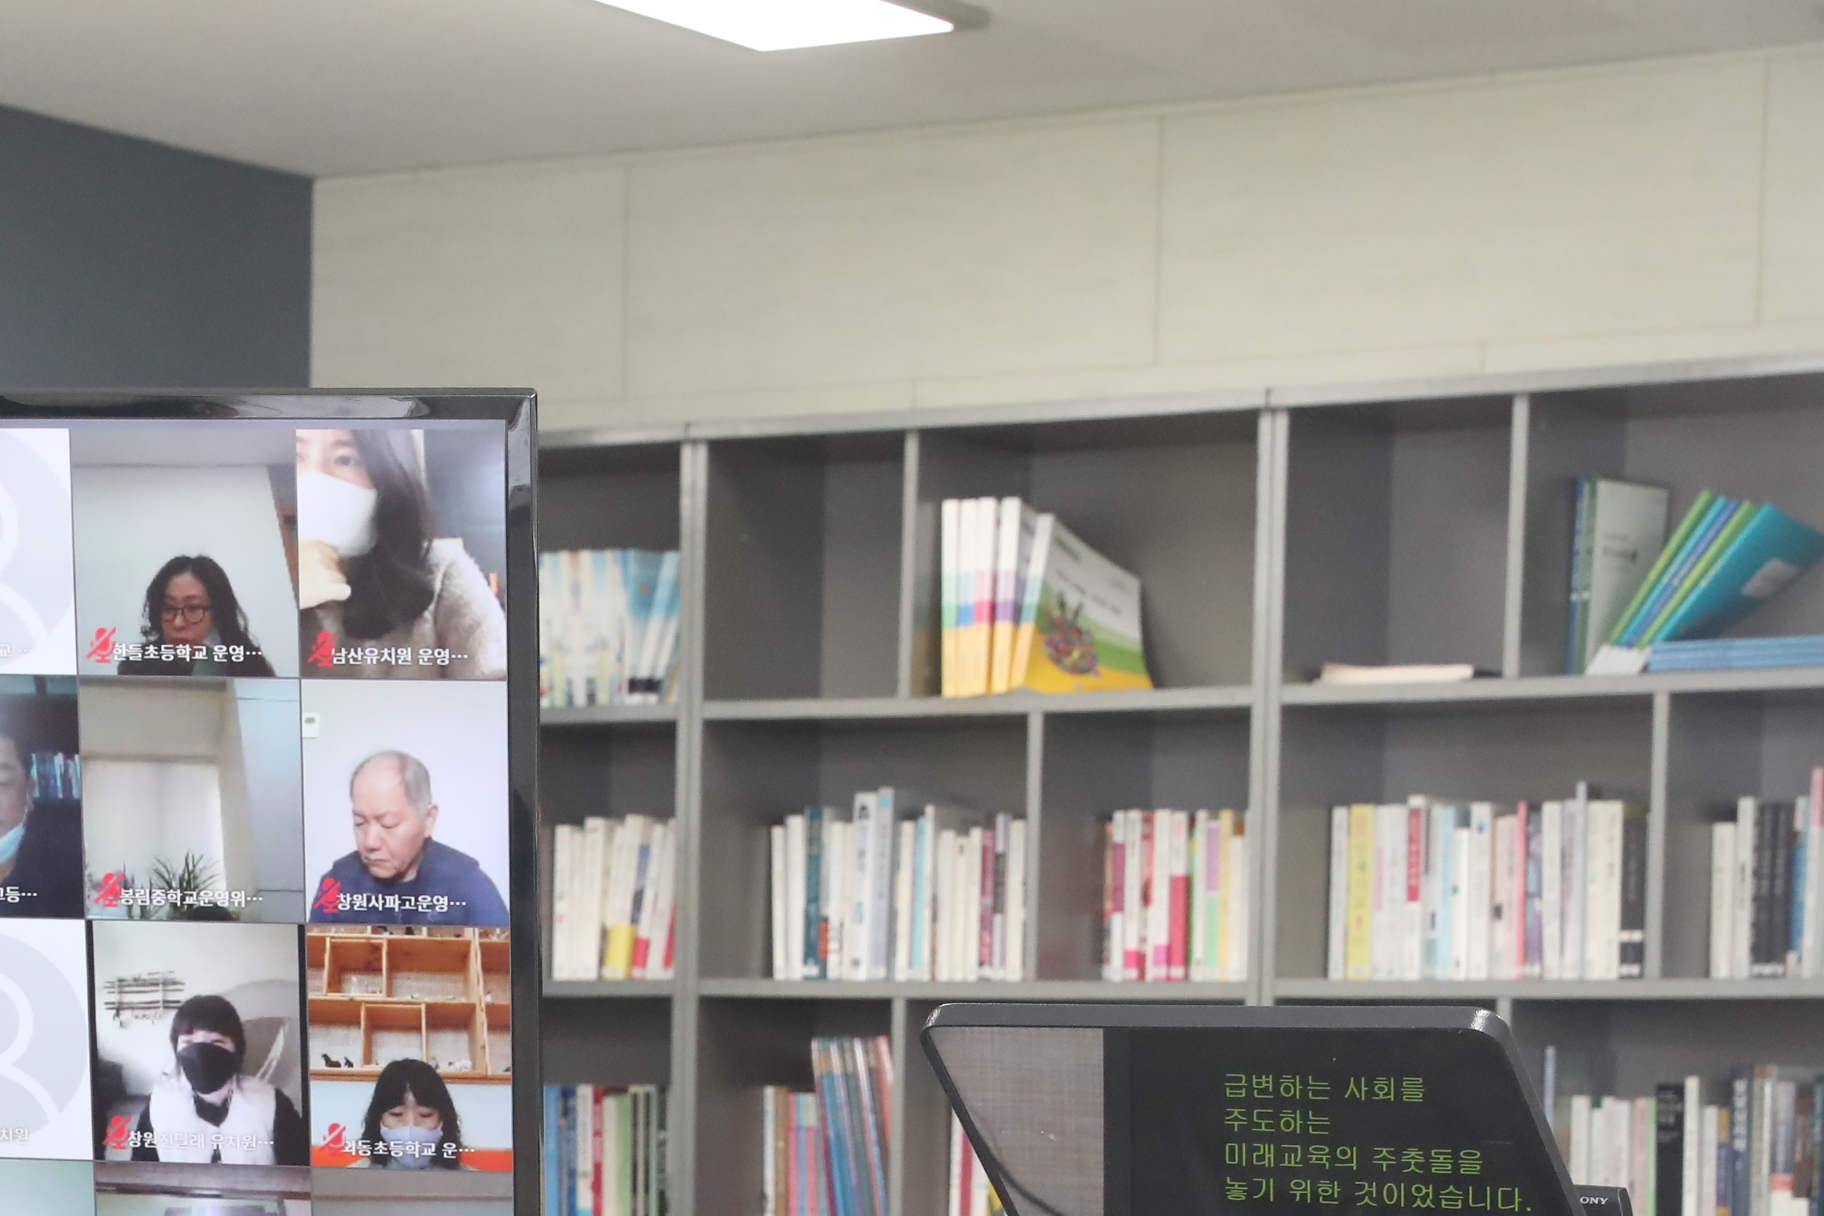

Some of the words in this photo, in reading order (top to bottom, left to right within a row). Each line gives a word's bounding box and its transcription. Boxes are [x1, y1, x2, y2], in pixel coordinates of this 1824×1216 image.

[113, 642, 208, 662] 한들초등학교
[330, 646, 412, 665] 남산유치원
[1223, 1072, 1332, 1103] 급변하는
[1344, 1075, 1427, 1104] 사회를
[1223, 1108, 1332, 1137] 주도하는
[128, 1131, 205, 1149] 창원진달래
[1223, 1143, 1359, 1172] 미래교육의
[1371, 1146, 1484, 1176] 주춧돌을
[1223, 1176, 1277, 1204] 놓기
[1288, 1179, 1342, 1207] 위한
[1353, 1181, 1534, 1214] 것이었습니다.
[1579, 1196, 1608, 1206] ONY
